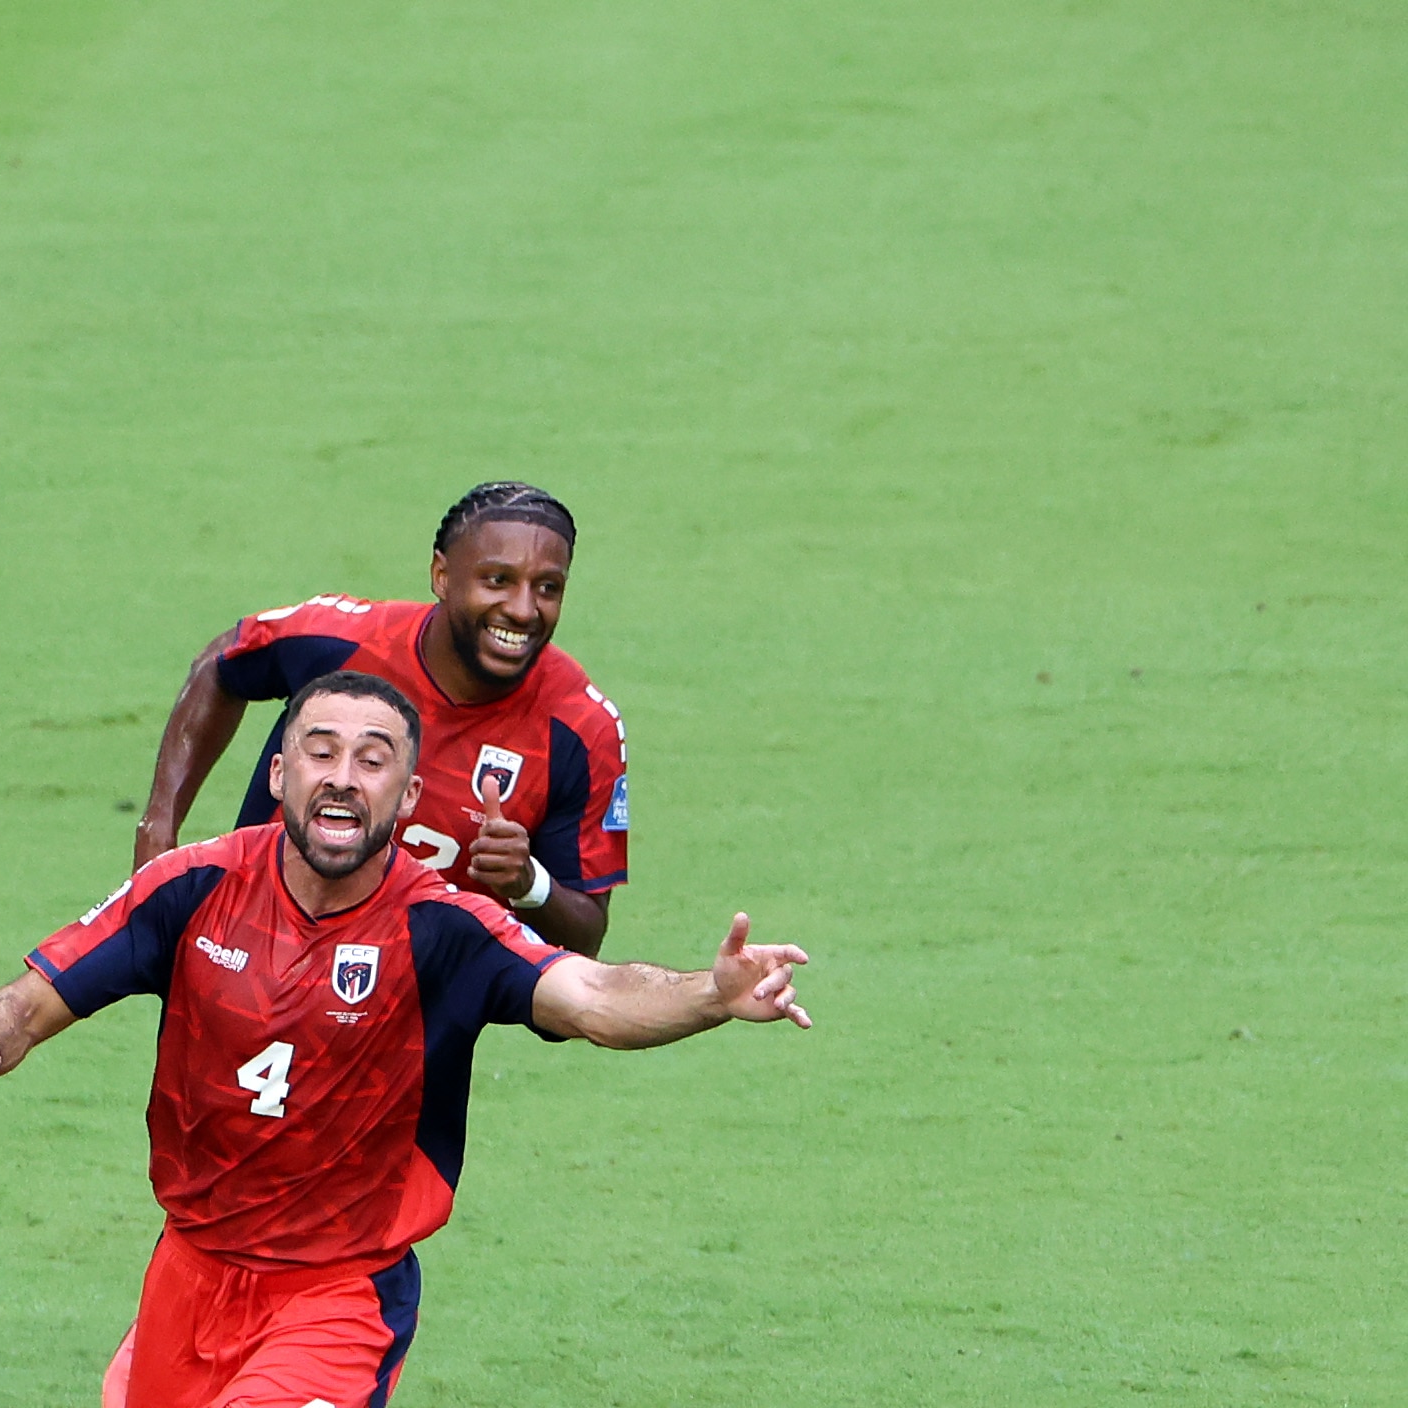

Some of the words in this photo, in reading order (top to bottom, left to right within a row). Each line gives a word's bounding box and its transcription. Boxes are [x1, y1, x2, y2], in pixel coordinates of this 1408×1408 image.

[484, 748, 520, 764] FCF
[196, 935, 249, 969] capelli
[339, 947, 376, 957] FCF
[236, 1040, 295, 1119] 4
